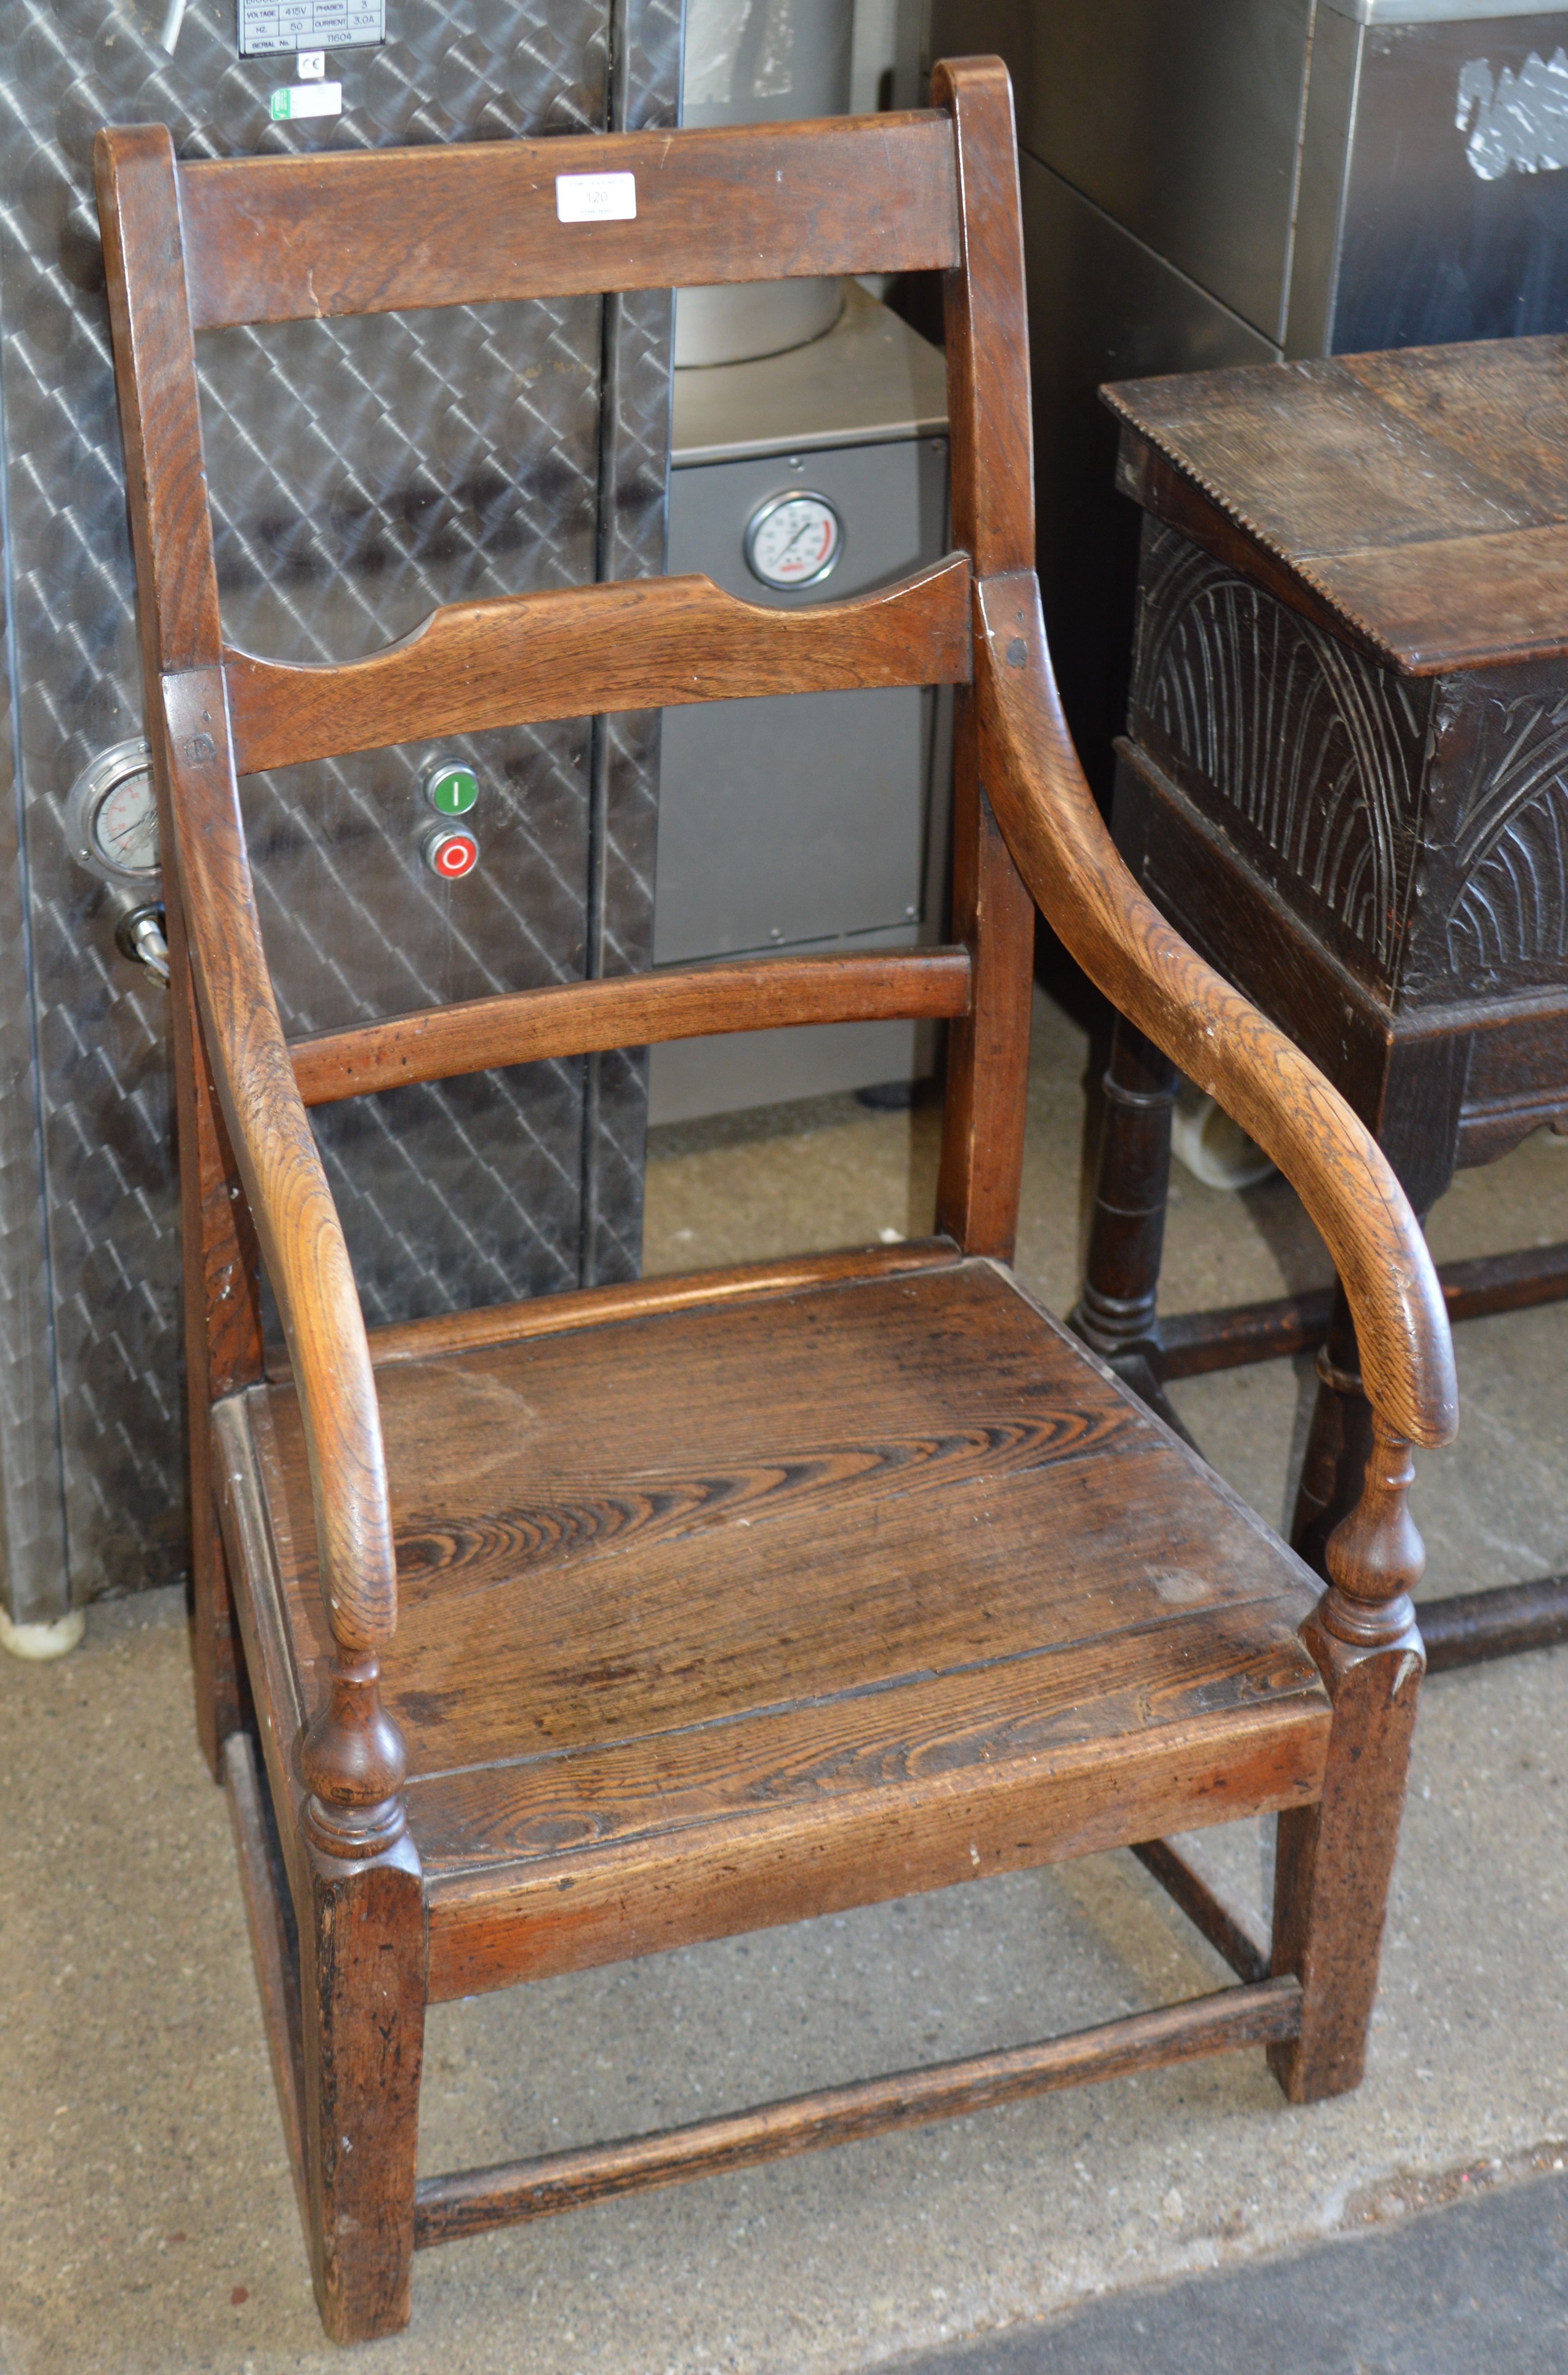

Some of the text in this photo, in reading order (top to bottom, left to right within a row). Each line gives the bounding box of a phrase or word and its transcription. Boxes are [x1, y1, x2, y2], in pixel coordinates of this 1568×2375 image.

[316, 4, 343, 12] PHASES
[361, 0, 367, 9] 3
[247, 10, 276, 18] VOLTAGE
[285, 7, 306, 16] 415V
[315, 19, 346, 28] CURRENT
[353, 15, 375, 25] 3.0A
[290, 23, 302, 31] 50
[327, 33, 352, 43] 11604
[586, 192, 608, 203] 120
